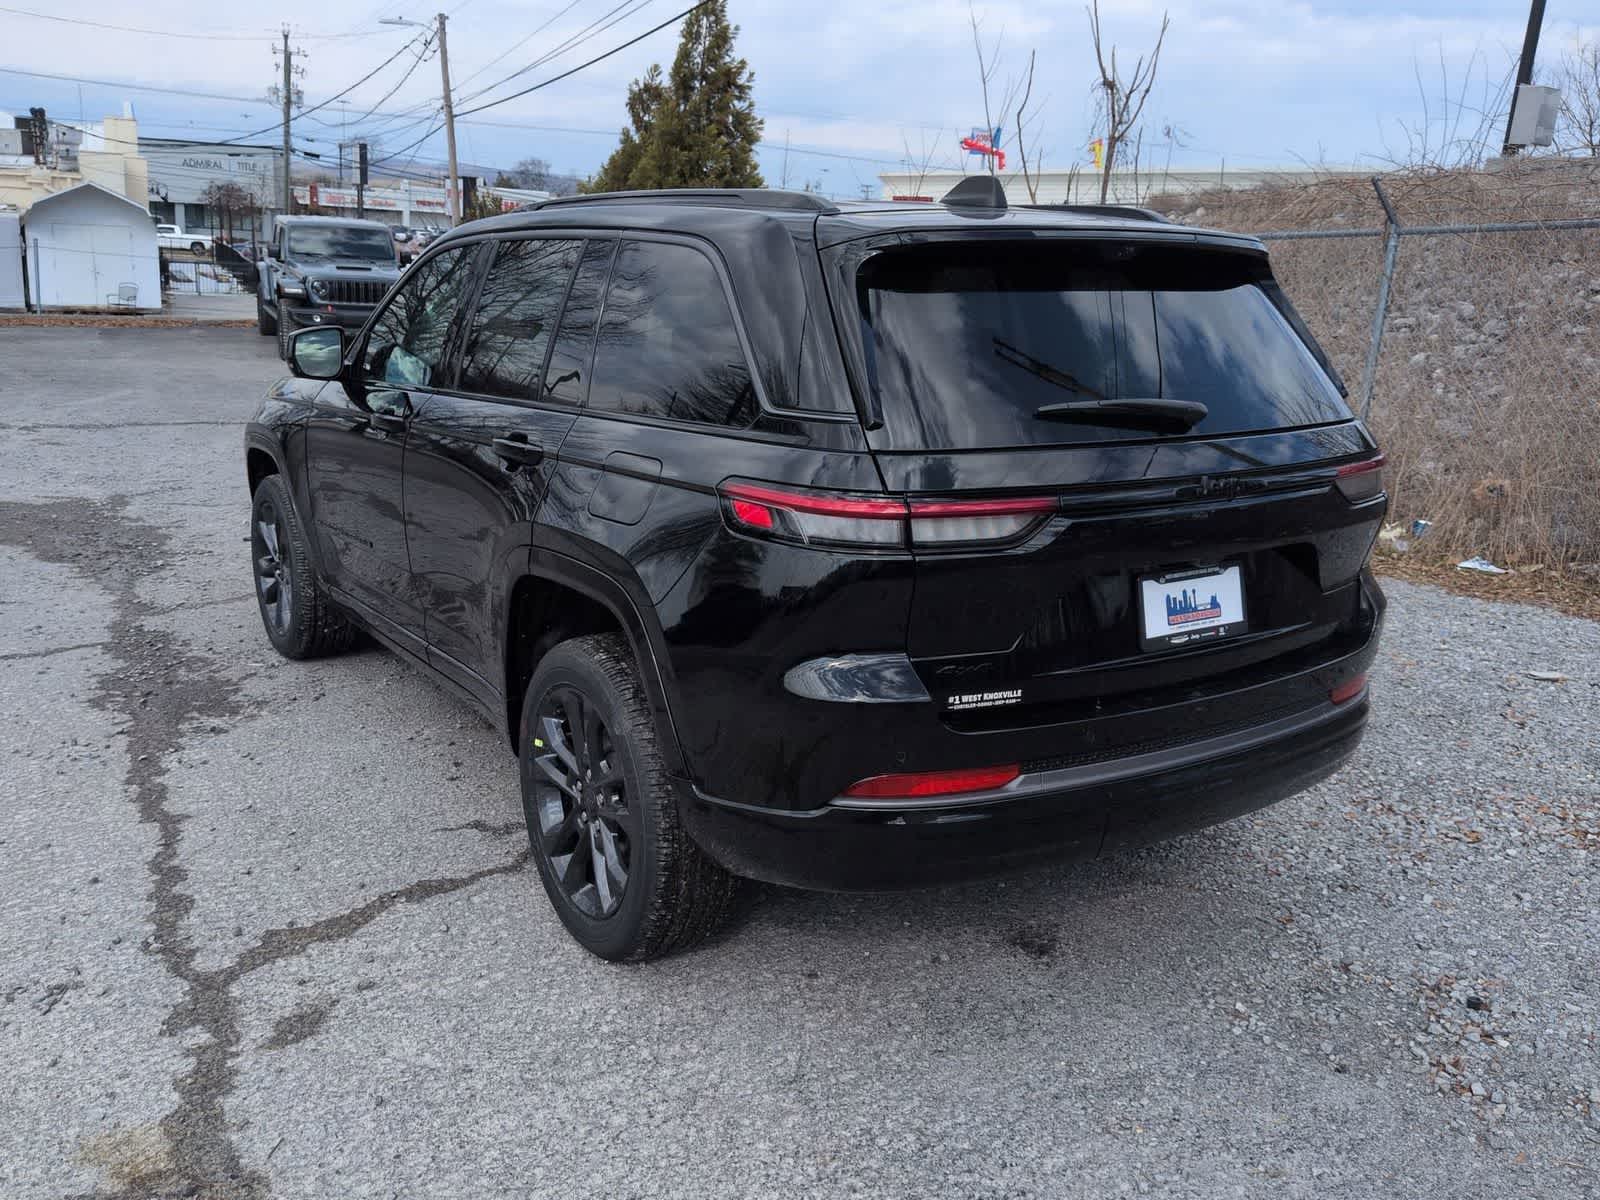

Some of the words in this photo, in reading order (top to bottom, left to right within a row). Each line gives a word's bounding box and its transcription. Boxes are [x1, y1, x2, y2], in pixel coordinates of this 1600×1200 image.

[182, 159, 223, 169] ADMIRAL
[961, 694, 982, 703] WEST
[983, 689, 1022, 701] KNOXVILLE
